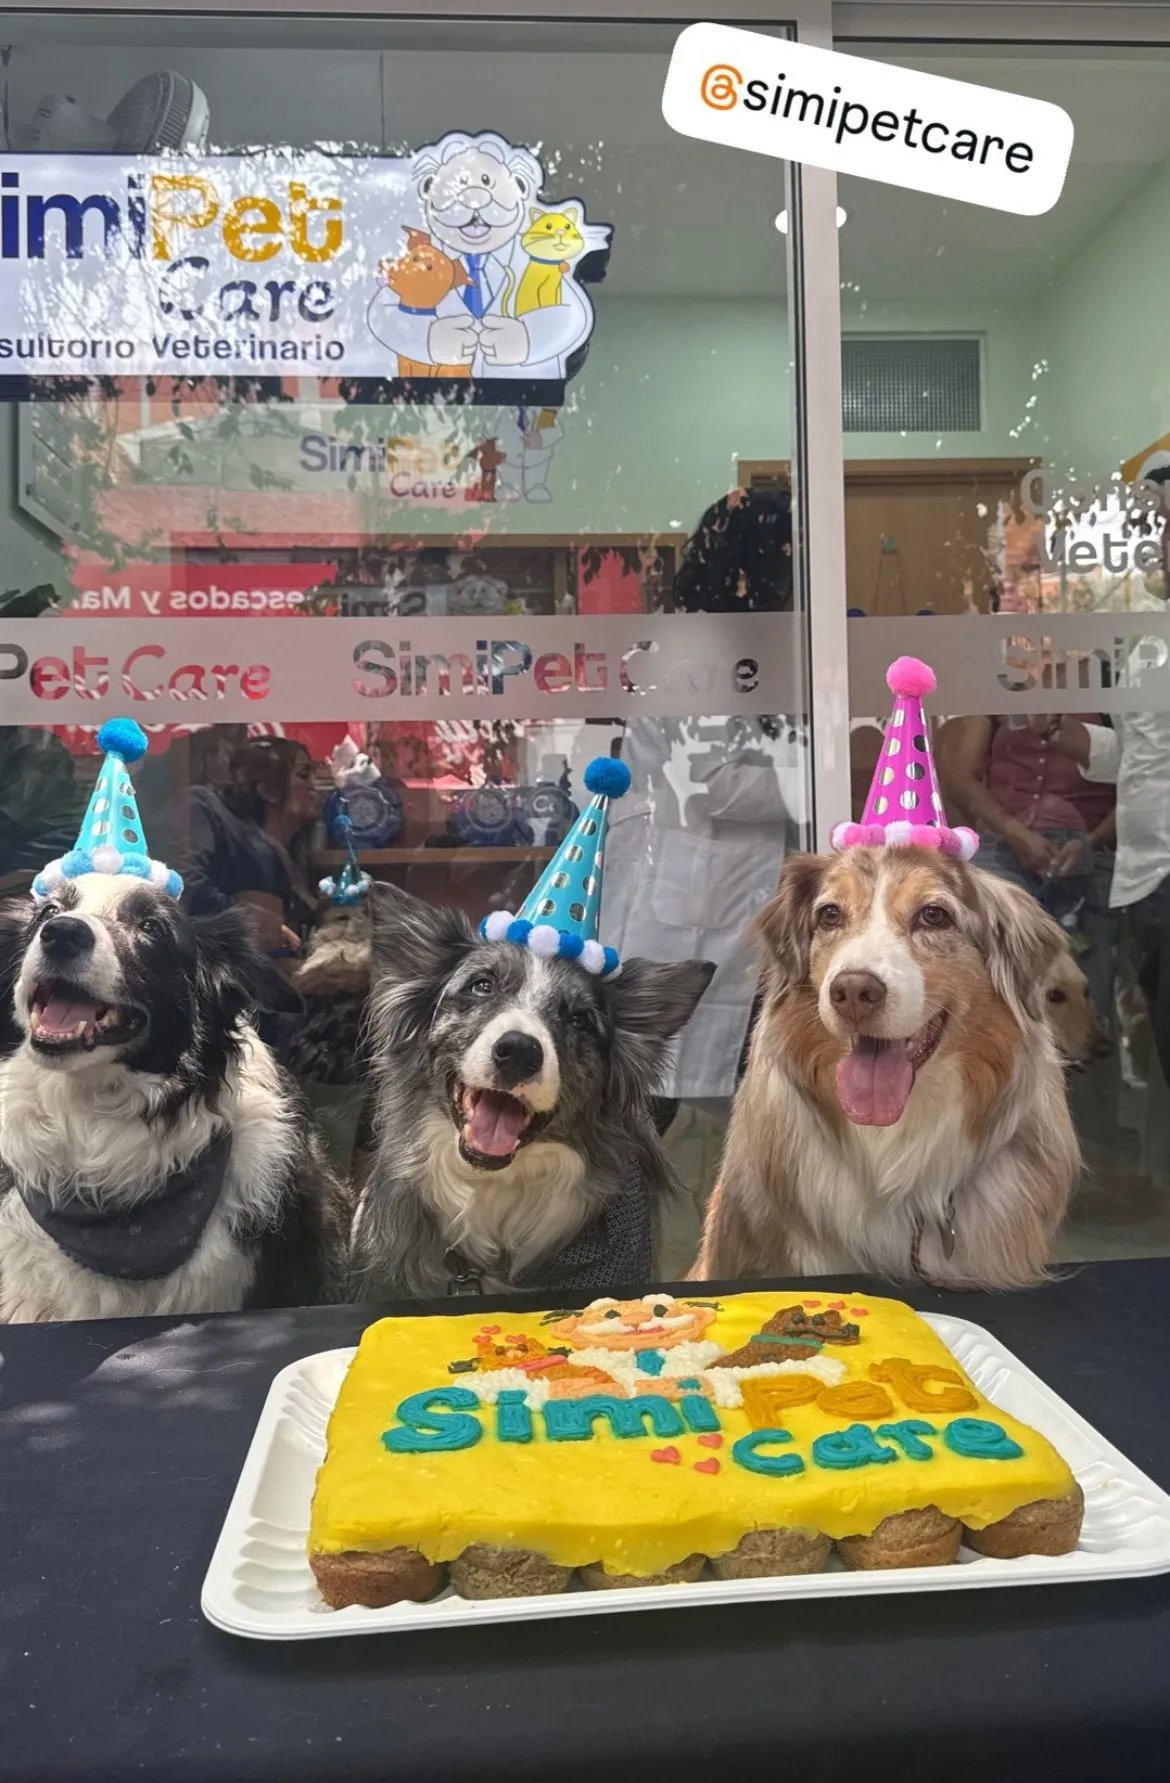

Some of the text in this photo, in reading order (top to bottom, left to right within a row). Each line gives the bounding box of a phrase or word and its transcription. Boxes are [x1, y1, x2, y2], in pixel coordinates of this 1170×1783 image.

[158, 256, 336, 323] Care
[152, 333, 346, 361] Veterinario
[389, 471, 457, 499] Care
[121, 644, 272, 701] Care
[353, 640, 607, 698] SimiPet
